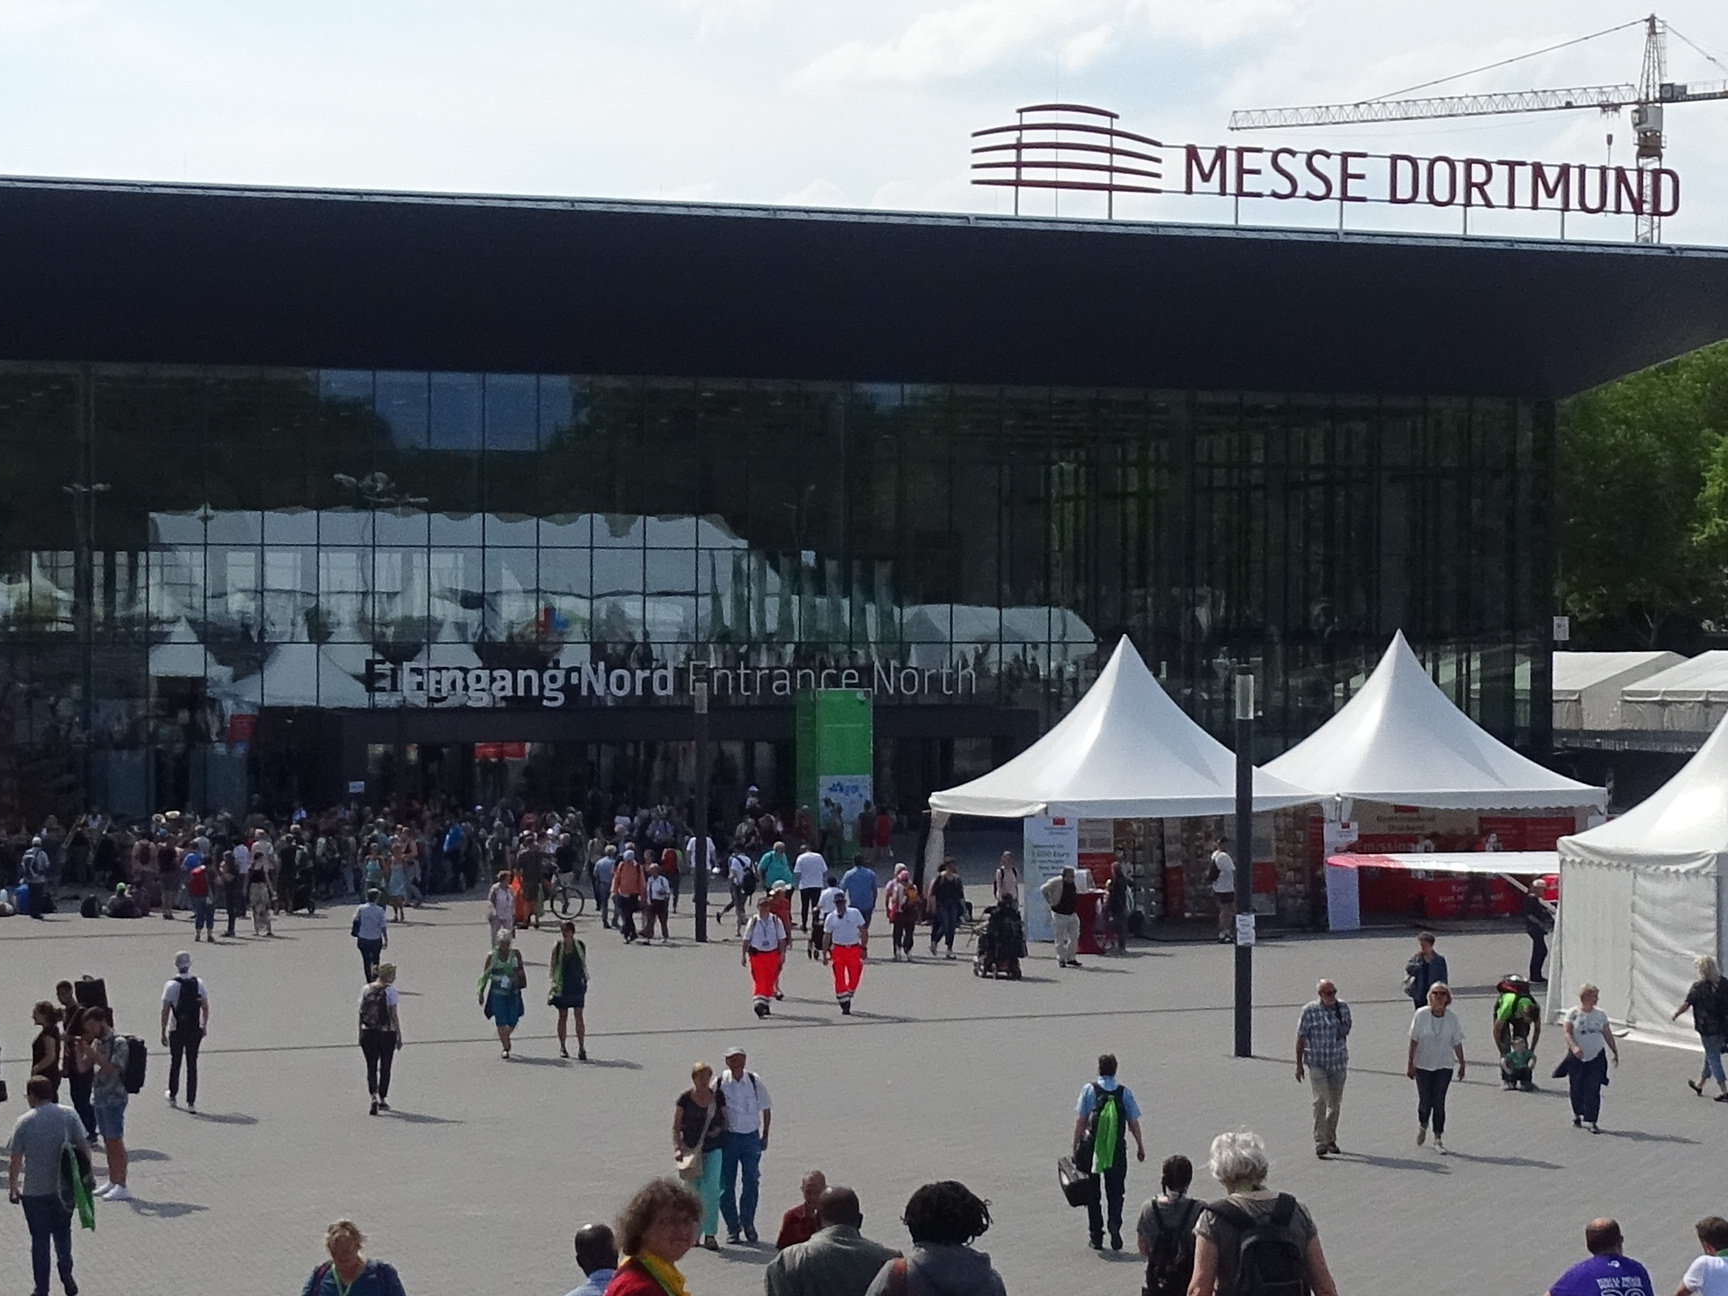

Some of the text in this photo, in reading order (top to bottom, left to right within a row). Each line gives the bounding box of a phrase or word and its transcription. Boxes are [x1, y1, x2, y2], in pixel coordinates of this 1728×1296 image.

[1185, 143, 1683, 218] MESSE DORTMUND
[402, 659, 975, 707] Eingang Nord Entrance North
